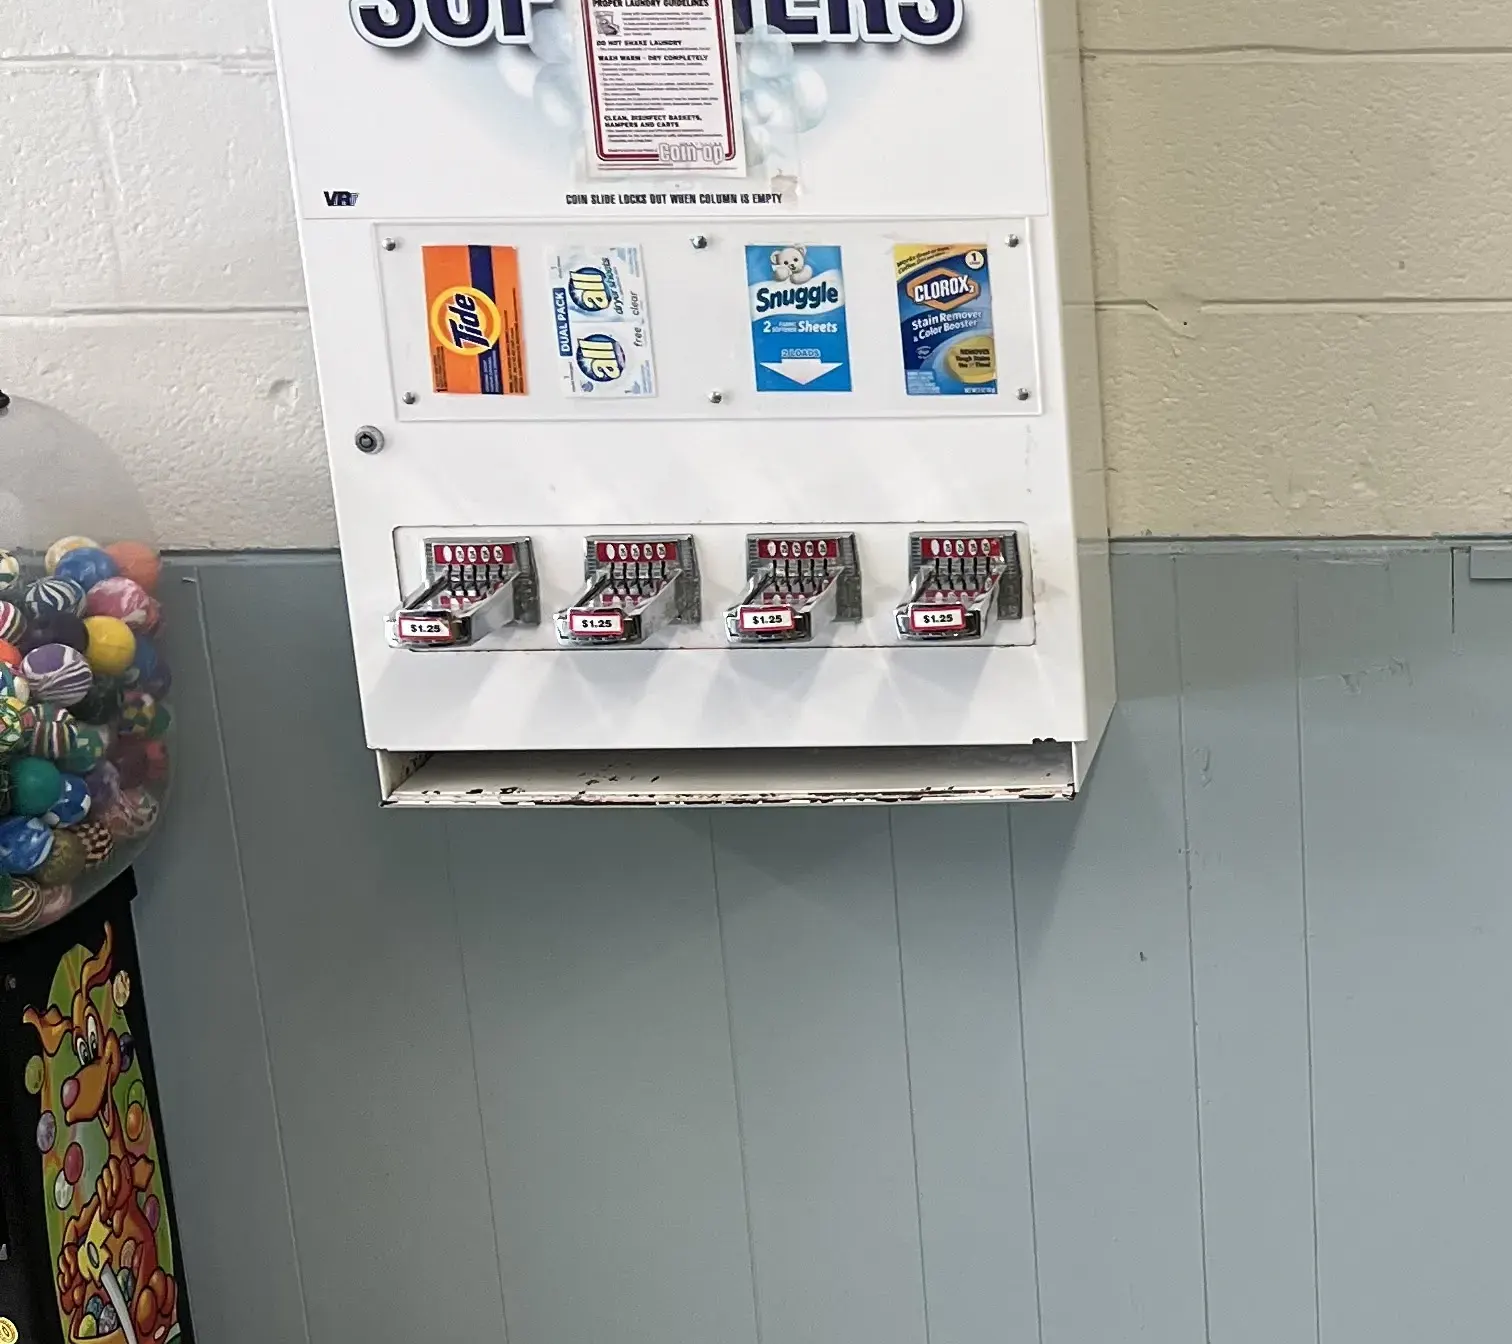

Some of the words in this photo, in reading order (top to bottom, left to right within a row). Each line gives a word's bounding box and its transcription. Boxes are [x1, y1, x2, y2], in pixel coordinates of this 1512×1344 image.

[592, 0, 623, 7] PROPER
[625, 0, 660, 7] LAUNDRY
[663, 0, 709, 7] GUIDELINES
[566, 194, 588, 205] COIN
[591, 194, 616, 205] SLIDE
[619, 194, 647, 204] LOCKS
[650, 194, 667, 204] OUT
[670, 194, 697, 204] WHEN
[700, 194, 738, 204] COLUMN
[741, 194, 750, 204] IS
[752, 193, 783, 204] EMPTY
[971, 253, 977, 261] 1
[570, 271, 611, 309] all
[756, 281, 839, 313] Snuggle
[914, 275, 969, 303] CLOROX
[554, 291, 567, 321] PACK
[630, 291, 640, 316] clear
[449, 292, 491, 348] Tide
[763, 320, 772, 333] 2
[798, 320, 838, 333] Sheets
[912, 316, 939, 331] Stain
[940, 311, 982, 323] Remover
[919, 326, 943, 340] Color
[943, 319, 978, 332] Booster
[558, 322, 571, 352] DUAL
[633, 327, 643, 347] free
[577, 338, 621, 379] all
[410, 624, 441, 633] $1.25
[582, 618, 612, 628] $1.25
[752, 614, 782, 624] $1.25
[923, 614, 953, 623] $1.25
